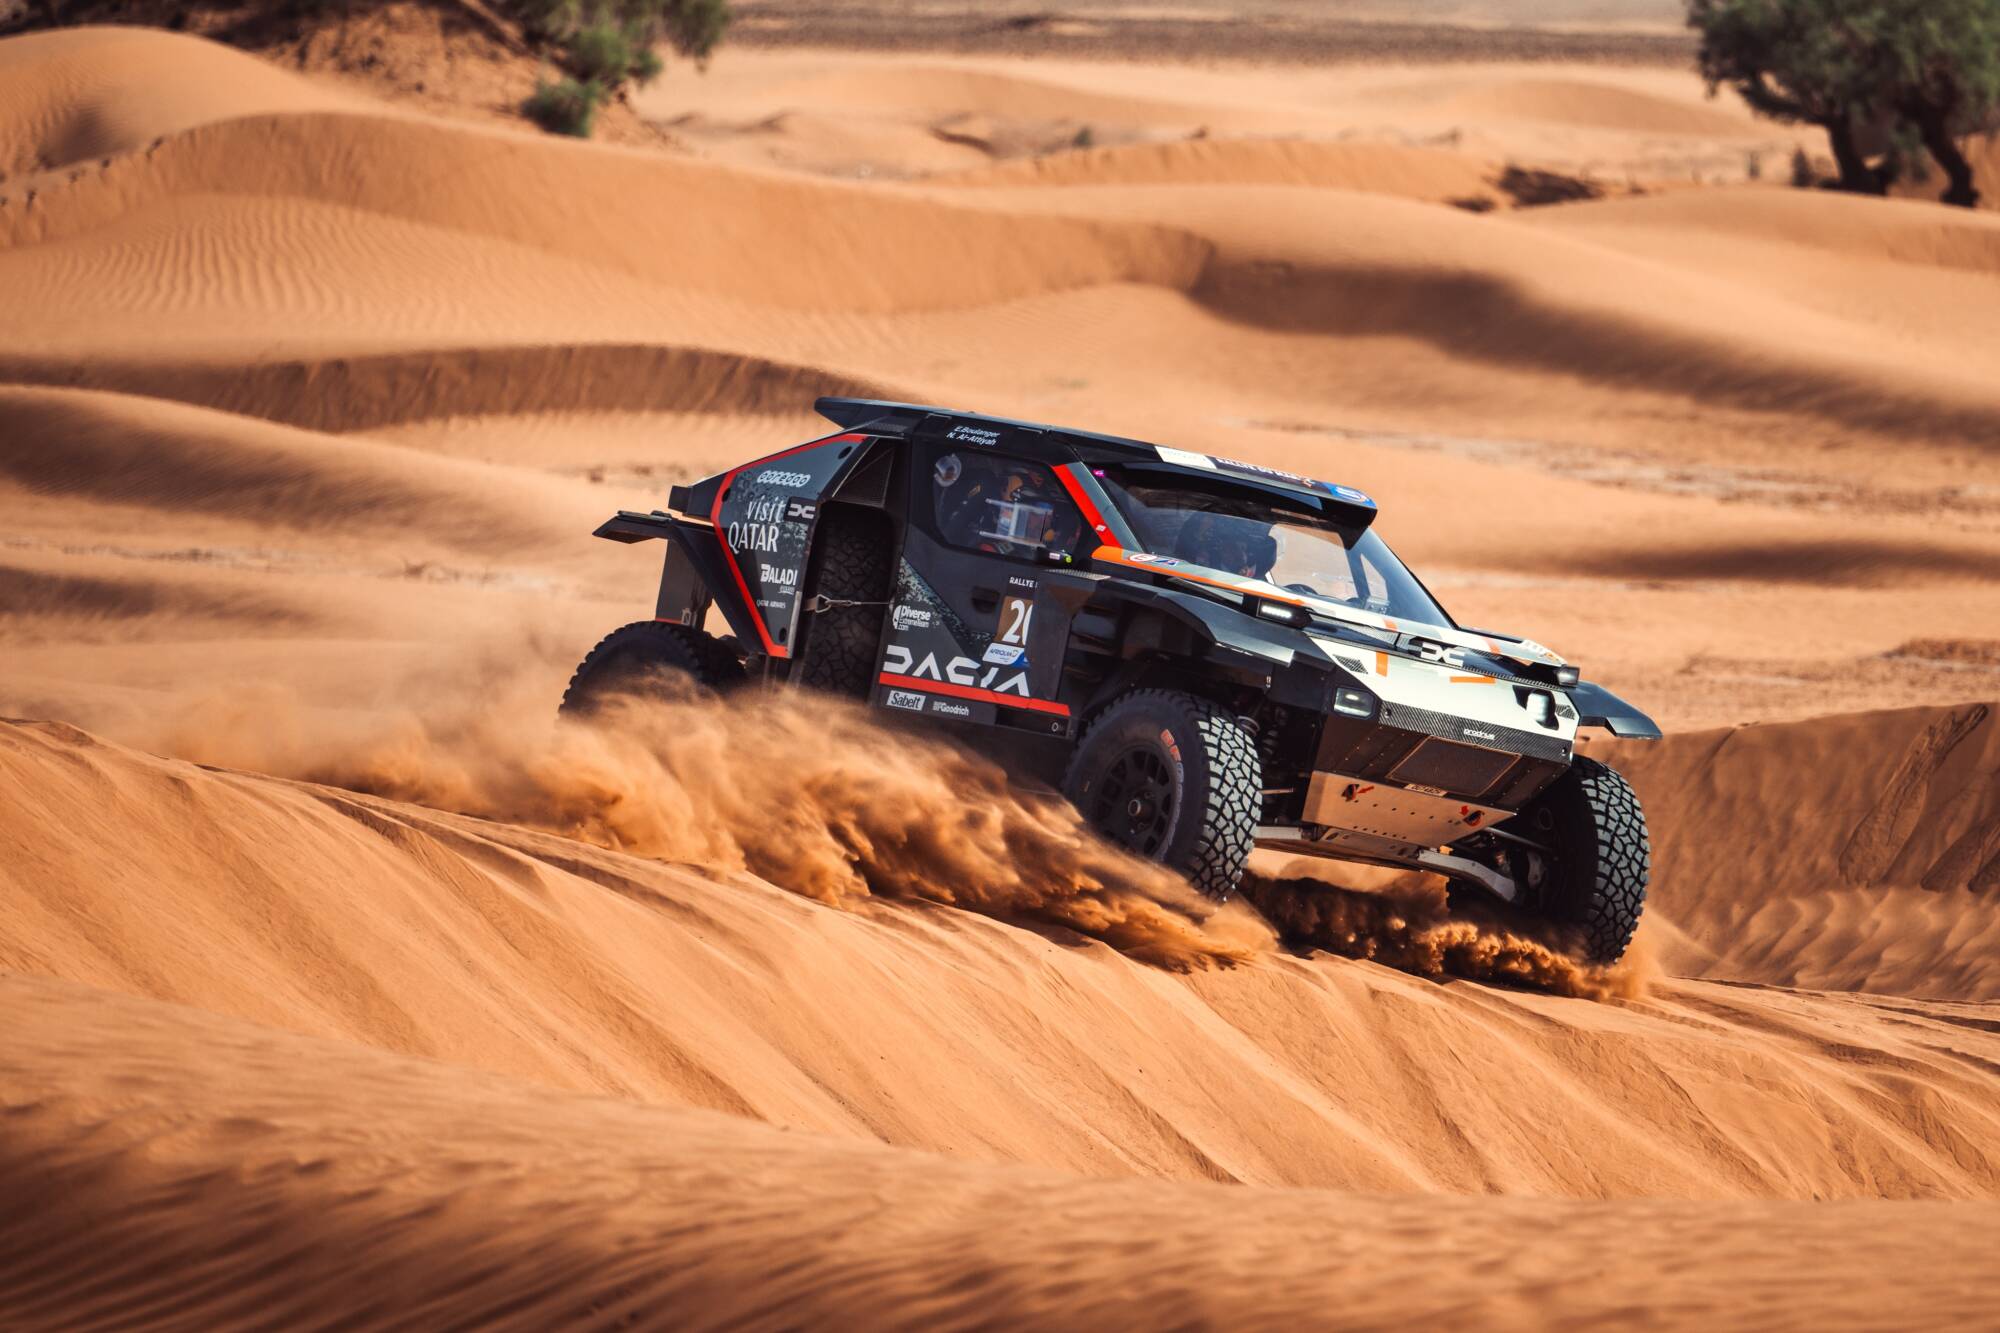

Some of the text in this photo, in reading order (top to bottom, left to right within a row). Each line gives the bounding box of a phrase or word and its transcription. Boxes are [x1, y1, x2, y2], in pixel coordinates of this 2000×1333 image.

[747, 495, 787, 523] visit
[728, 521, 779, 554] QATAR
[760, 563, 798, 586] BALADI
[1009, 576, 1035, 588] RALLYE
[900, 604, 930, 621] Diverse
[883, 644, 1030, 698] DACIA
